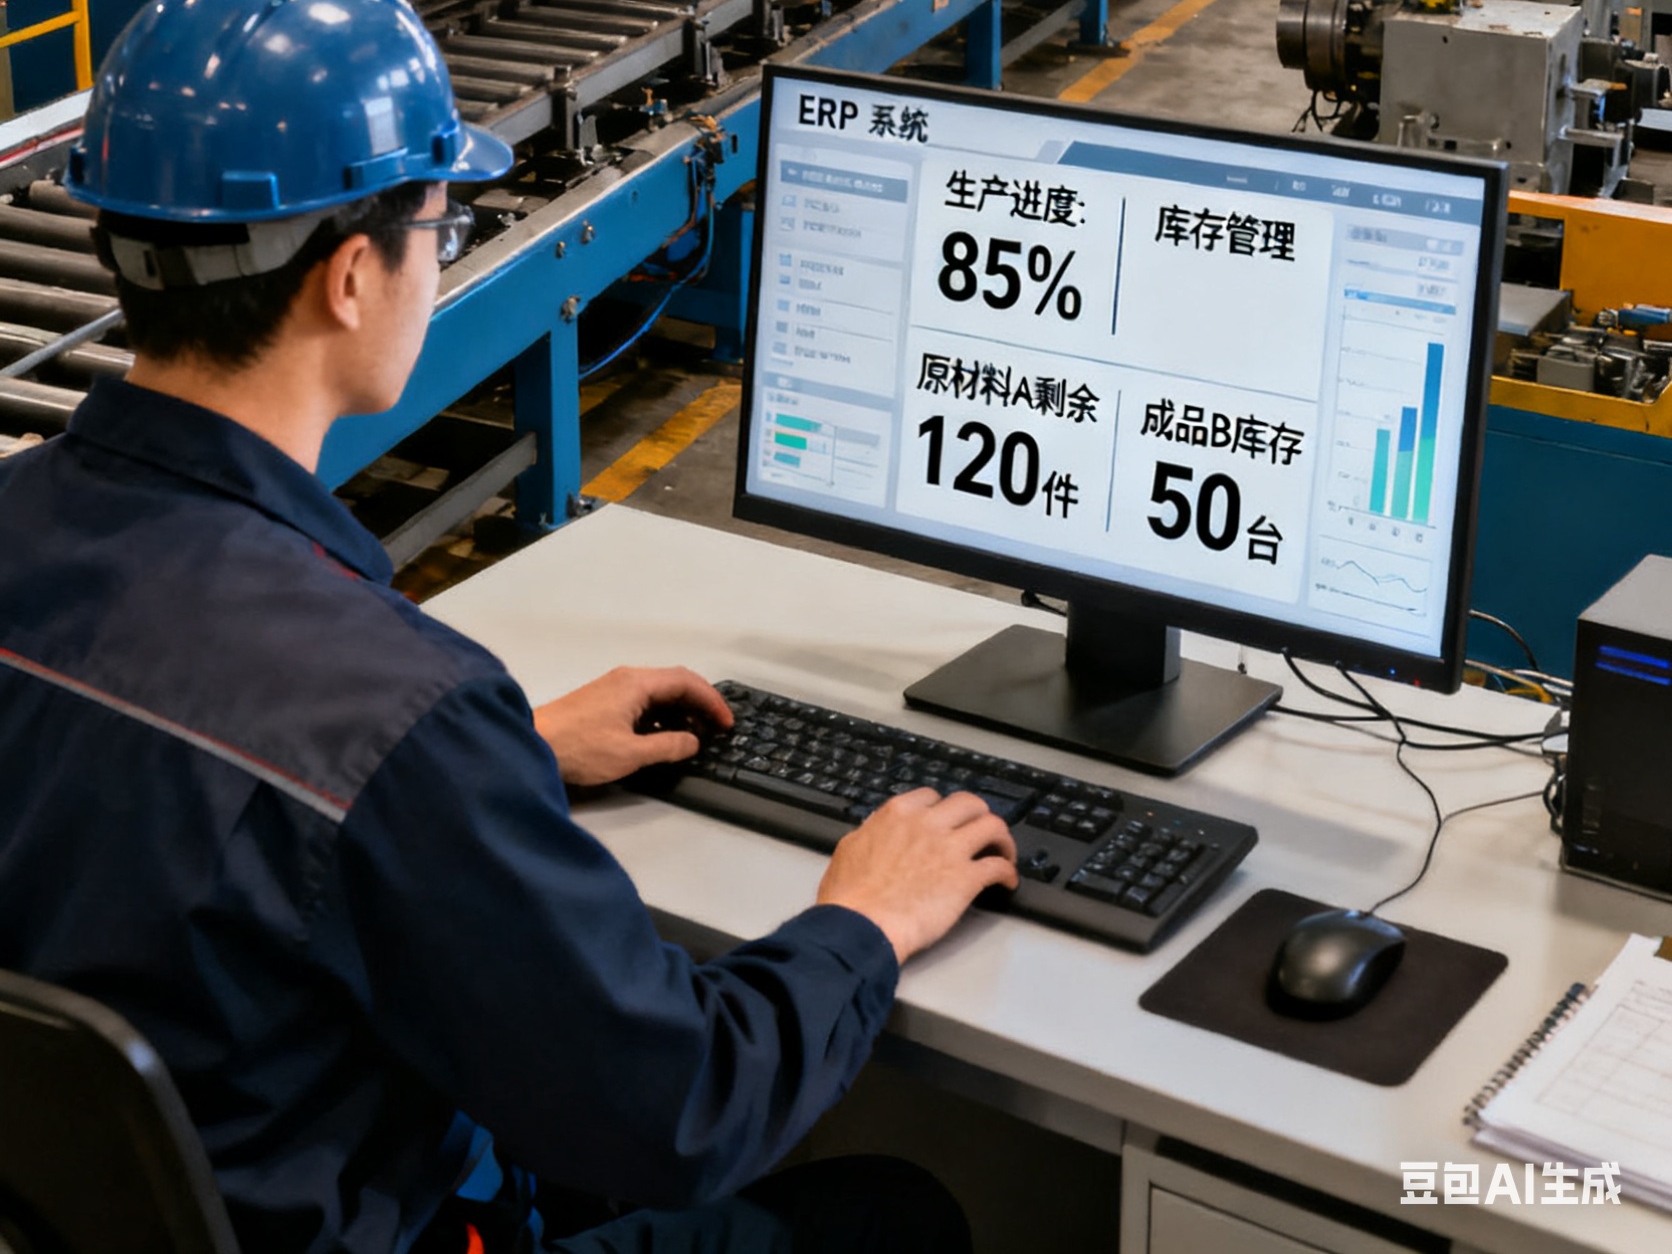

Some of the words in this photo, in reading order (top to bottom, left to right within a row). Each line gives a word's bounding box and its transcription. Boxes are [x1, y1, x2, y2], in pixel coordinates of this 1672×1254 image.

[798, 93, 858, 131] ERP
[868, 103, 928, 144] 系统
[944, 169, 1086, 229] 生产进度:
[1153, 203, 1296, 263] 库存管理
[937, 231, 1082, 321] 85%
[916, 352, 1101, 424] 原材料A剩余
[1140, 398, 1305, 465] 成品B库存
